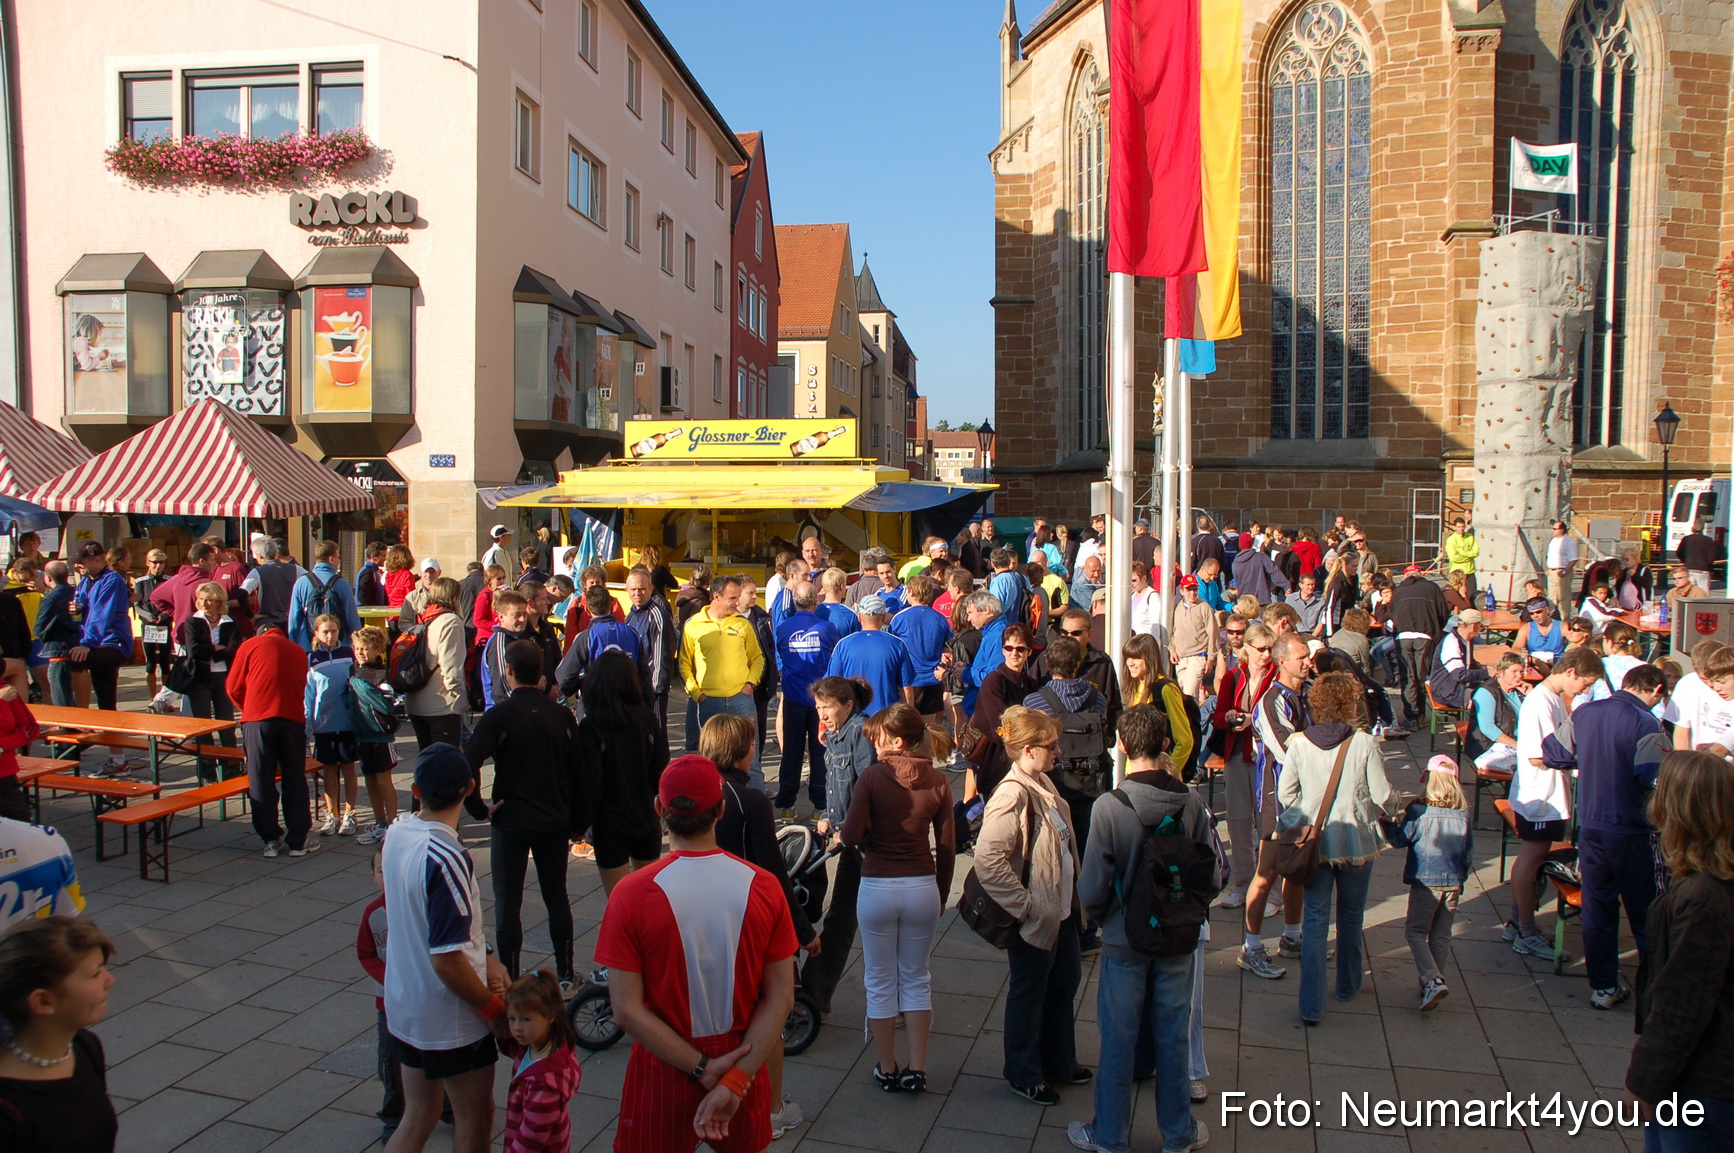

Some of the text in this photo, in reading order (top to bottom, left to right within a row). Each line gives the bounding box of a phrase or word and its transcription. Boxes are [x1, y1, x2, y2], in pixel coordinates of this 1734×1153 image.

[1530, 157, 1567, 174] DAV
[289, 190, 414, 226] RACKL
[214, 293, 238, 305] Jahre
[688, 425, 787, 452] Glossner-Bier
